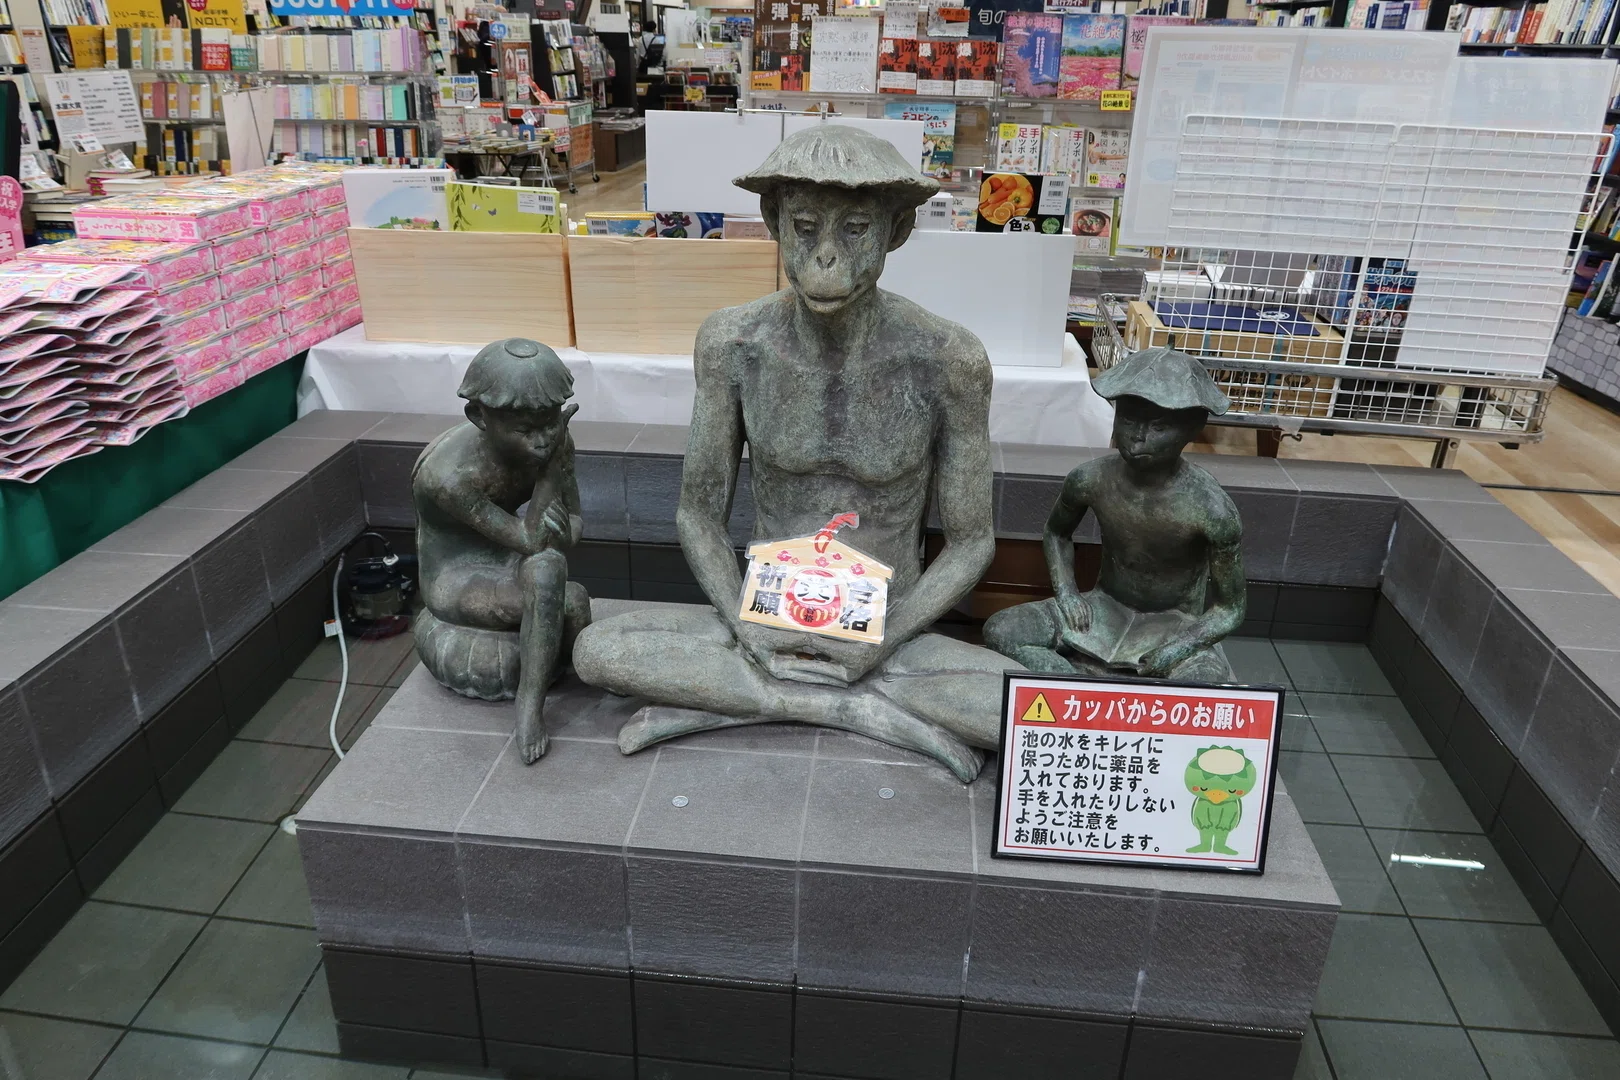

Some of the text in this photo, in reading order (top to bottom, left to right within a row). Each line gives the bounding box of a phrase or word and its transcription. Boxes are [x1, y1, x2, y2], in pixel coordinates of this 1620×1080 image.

[195, 17, 238, 26] NOLTY
[1130, 28, 1145, 43] 桜
[56, 101, 82, 110] 本屋大賞
[902, 111, 940, 122] デコピンの
[1018, 128, 1028, 154] 足ツボ
[1029, 128, 1040, 154] 手ツボ
[1073, 131, 1083, 157] 手ツボ
[1, 181, 14, 197] 祝
[1009, 219, 1022, 232] 色
[749, 563, 787, 616] 祈願
[1062, 694, 1255, 730] カッパからのお願い
[1021, 730, 1164, 755] 池の水をキレイに
[1020, 749, 1161, 775] 保つために薬品を
[1018, 770, 1149, 794] 入れております。
[1017, 788, 1175, 814] 手を入れたりしない
[1015, 808, 1118, 830] ようご注意を
[1014, 827, 1160, 853] お願いいたします。
